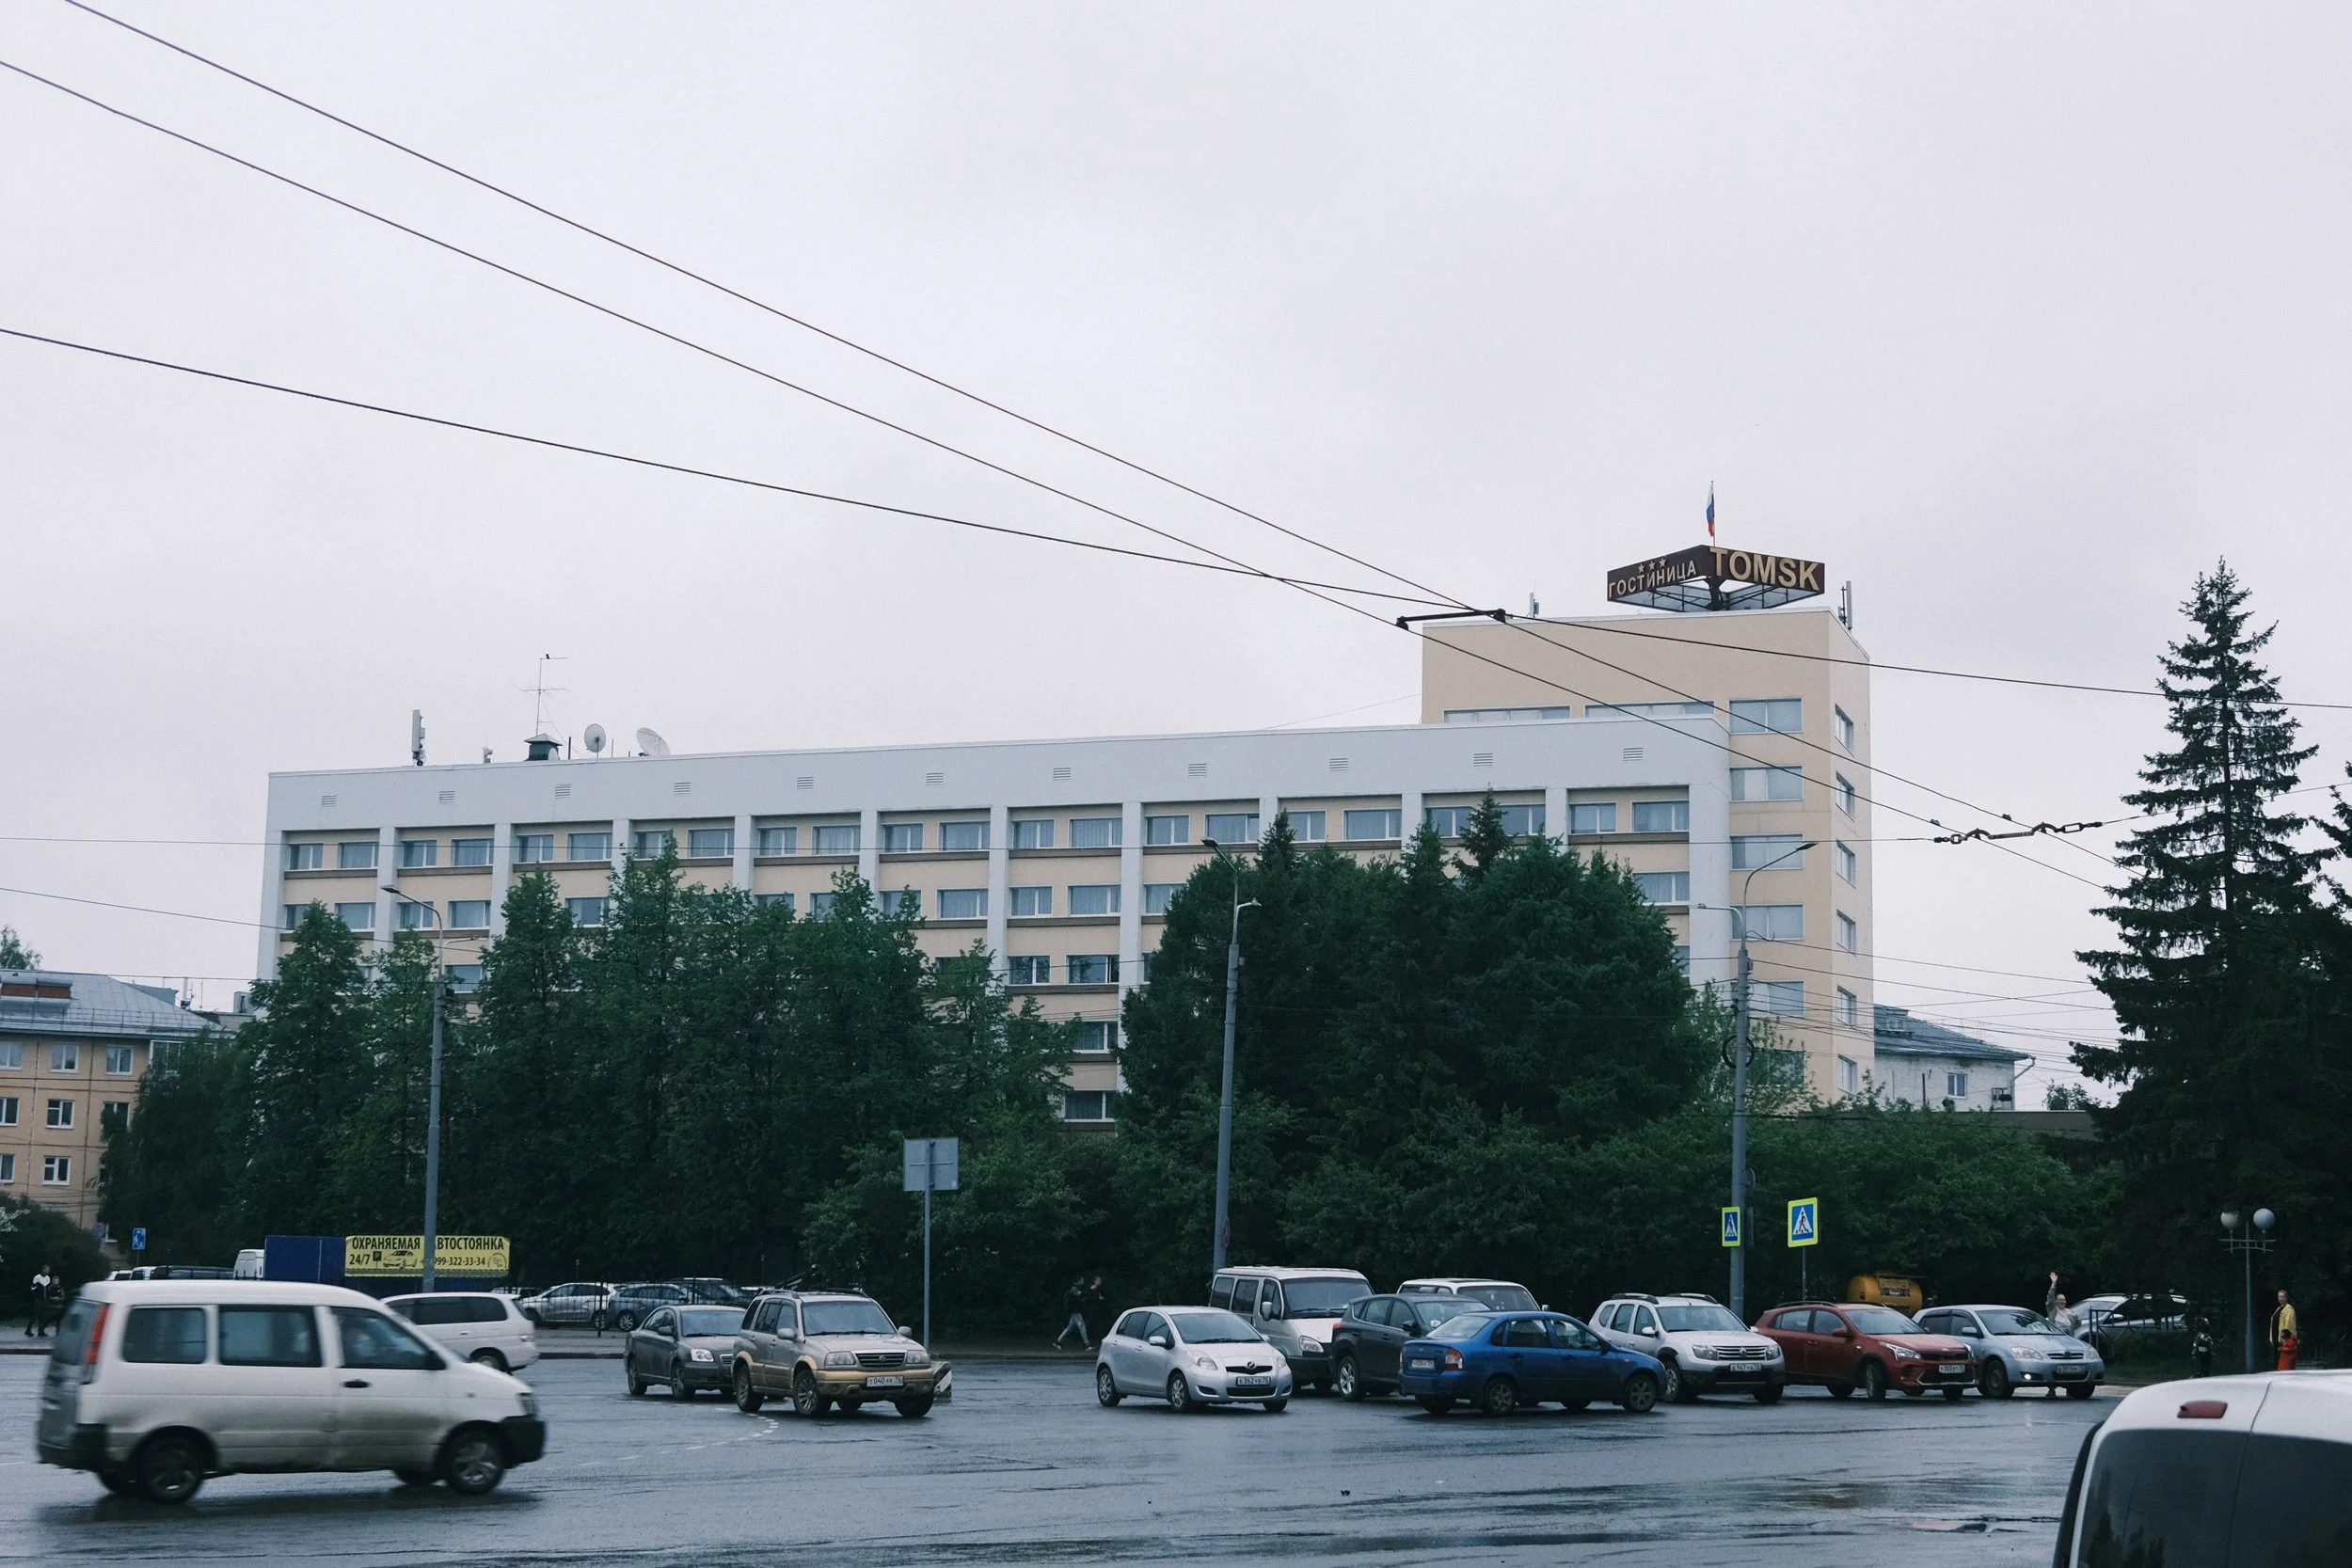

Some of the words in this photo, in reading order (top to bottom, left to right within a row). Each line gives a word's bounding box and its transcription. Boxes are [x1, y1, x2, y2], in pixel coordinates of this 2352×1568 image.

[1608, 560, 1697, 598] ГОСТИНИЦА
[1708, 546, 1820, 592] TOMSK
[352, 1236, 421, 1250] ОХРАНЯЕМАЯ
[433, 1236, 504, 1250] ВТОСТОЯНКА
[349, 1254, 370, 1265] 24/7
